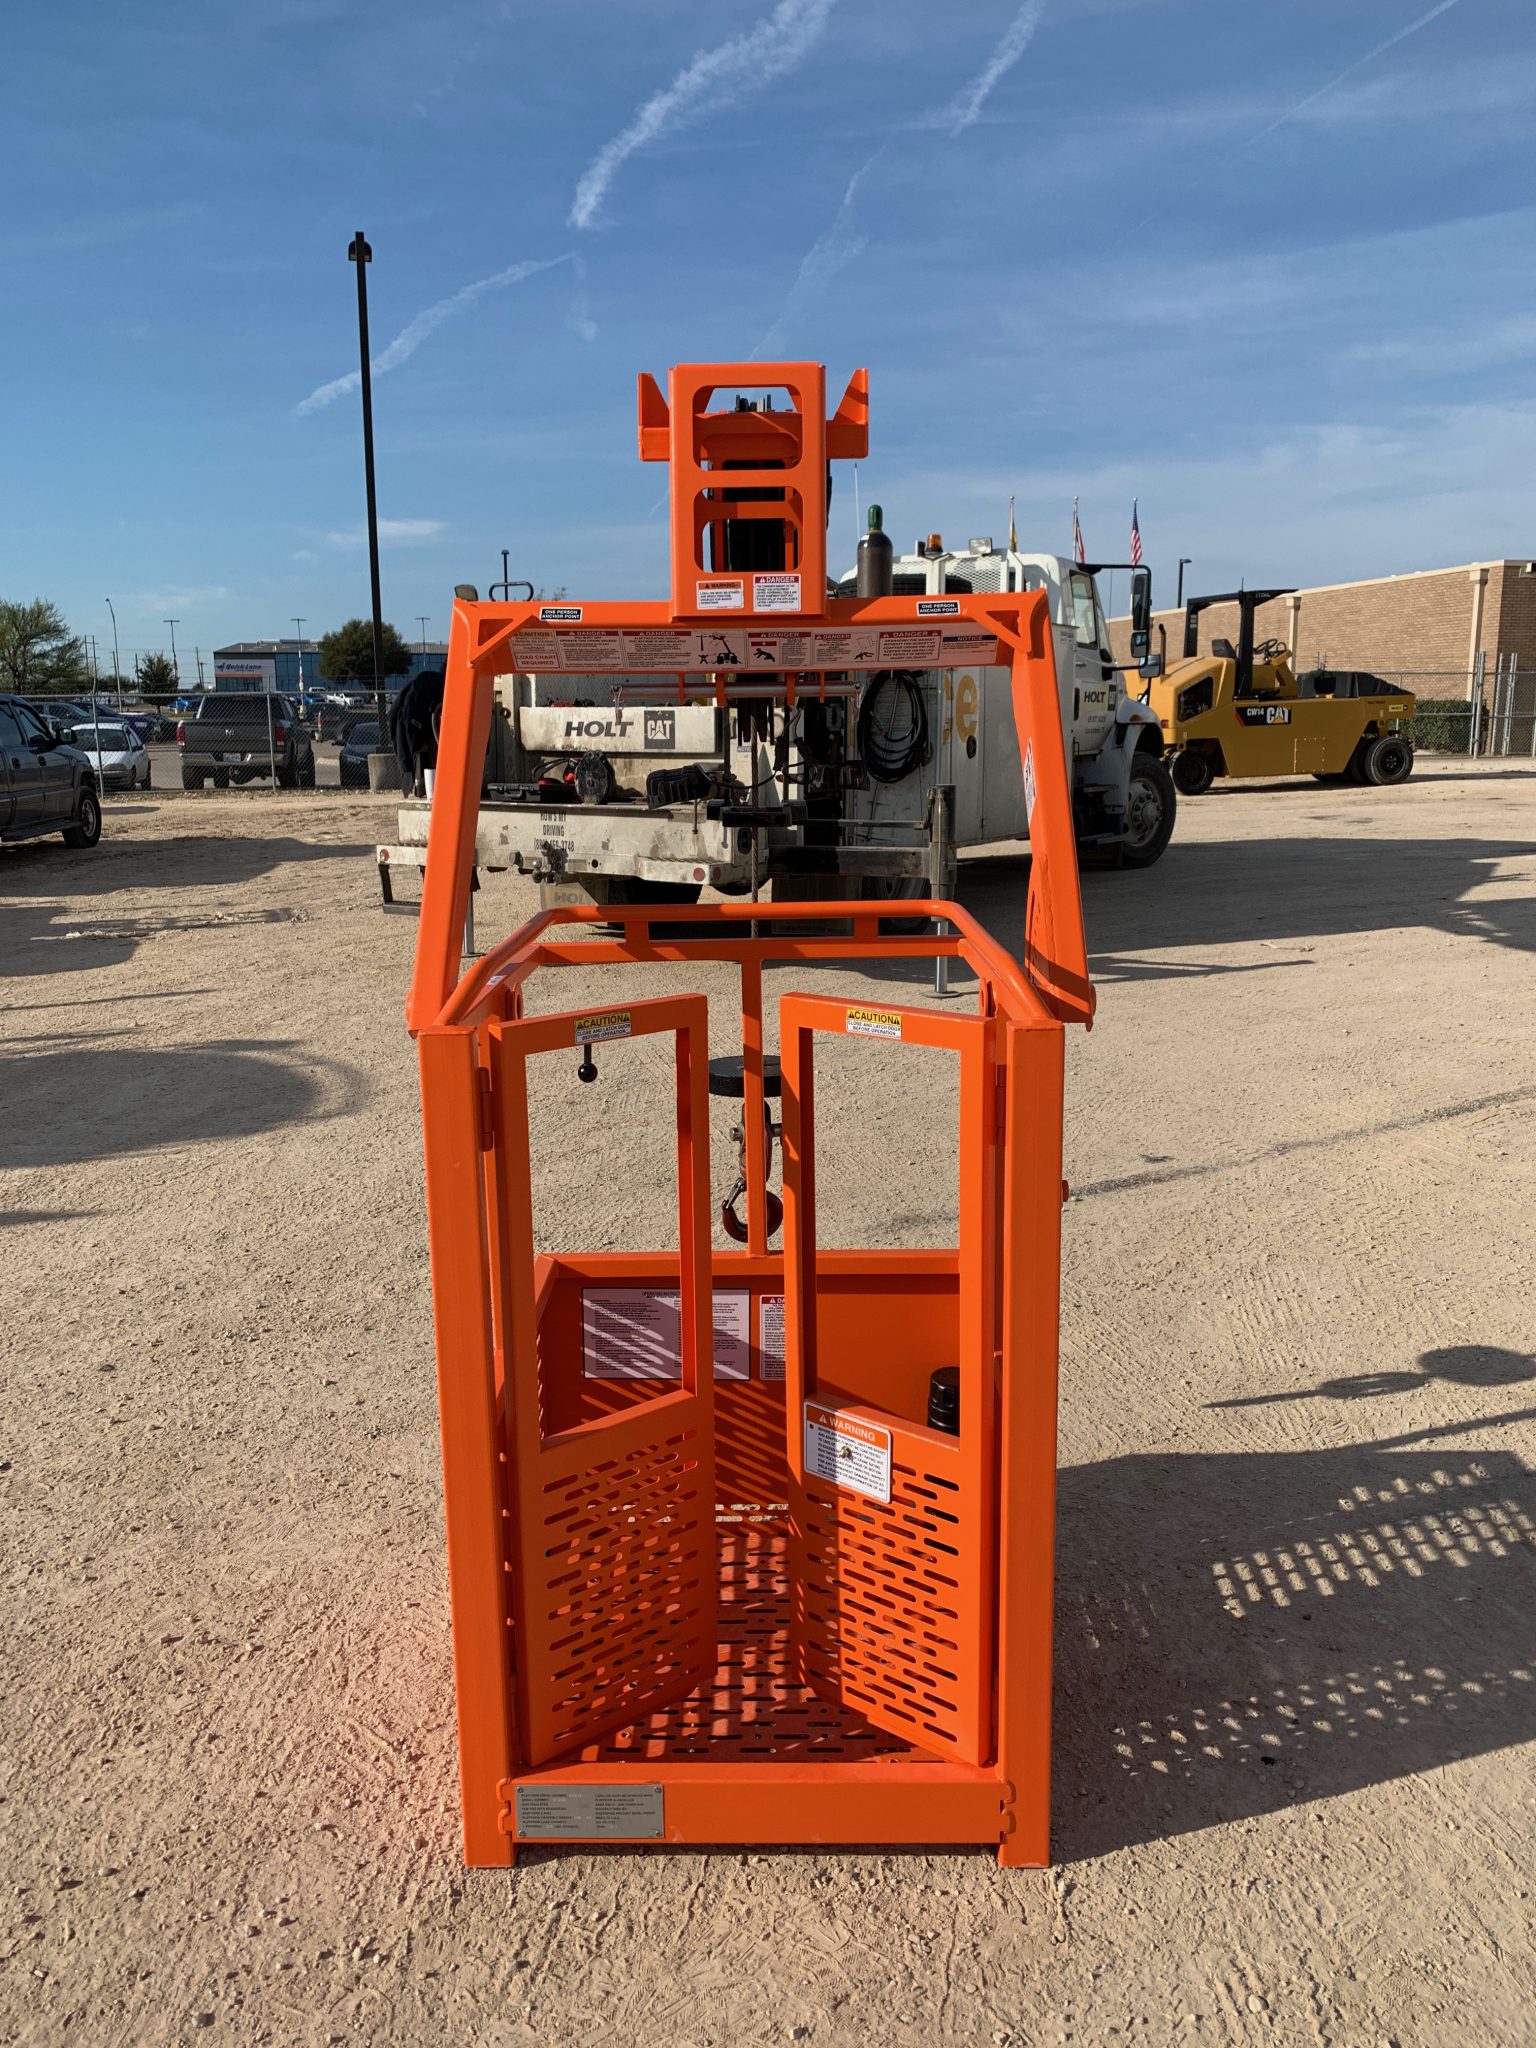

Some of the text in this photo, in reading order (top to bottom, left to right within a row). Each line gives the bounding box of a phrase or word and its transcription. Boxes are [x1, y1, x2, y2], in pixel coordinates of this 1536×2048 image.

[1084, 691, 1106, 703] HOLT
[1247, 706, 1289, 724] CW14 CAT
[564, 720, 672, 740] HOLT CAT
[543, 825, 564, 836] DRIVING
[583, 1014, 624, 1028] CAUTION
[854, 1011, 894, 1024] CAUTION
[871, 1028, 895, 1036] OPERATION
[829, 1416, 875, 1441] WARNING
